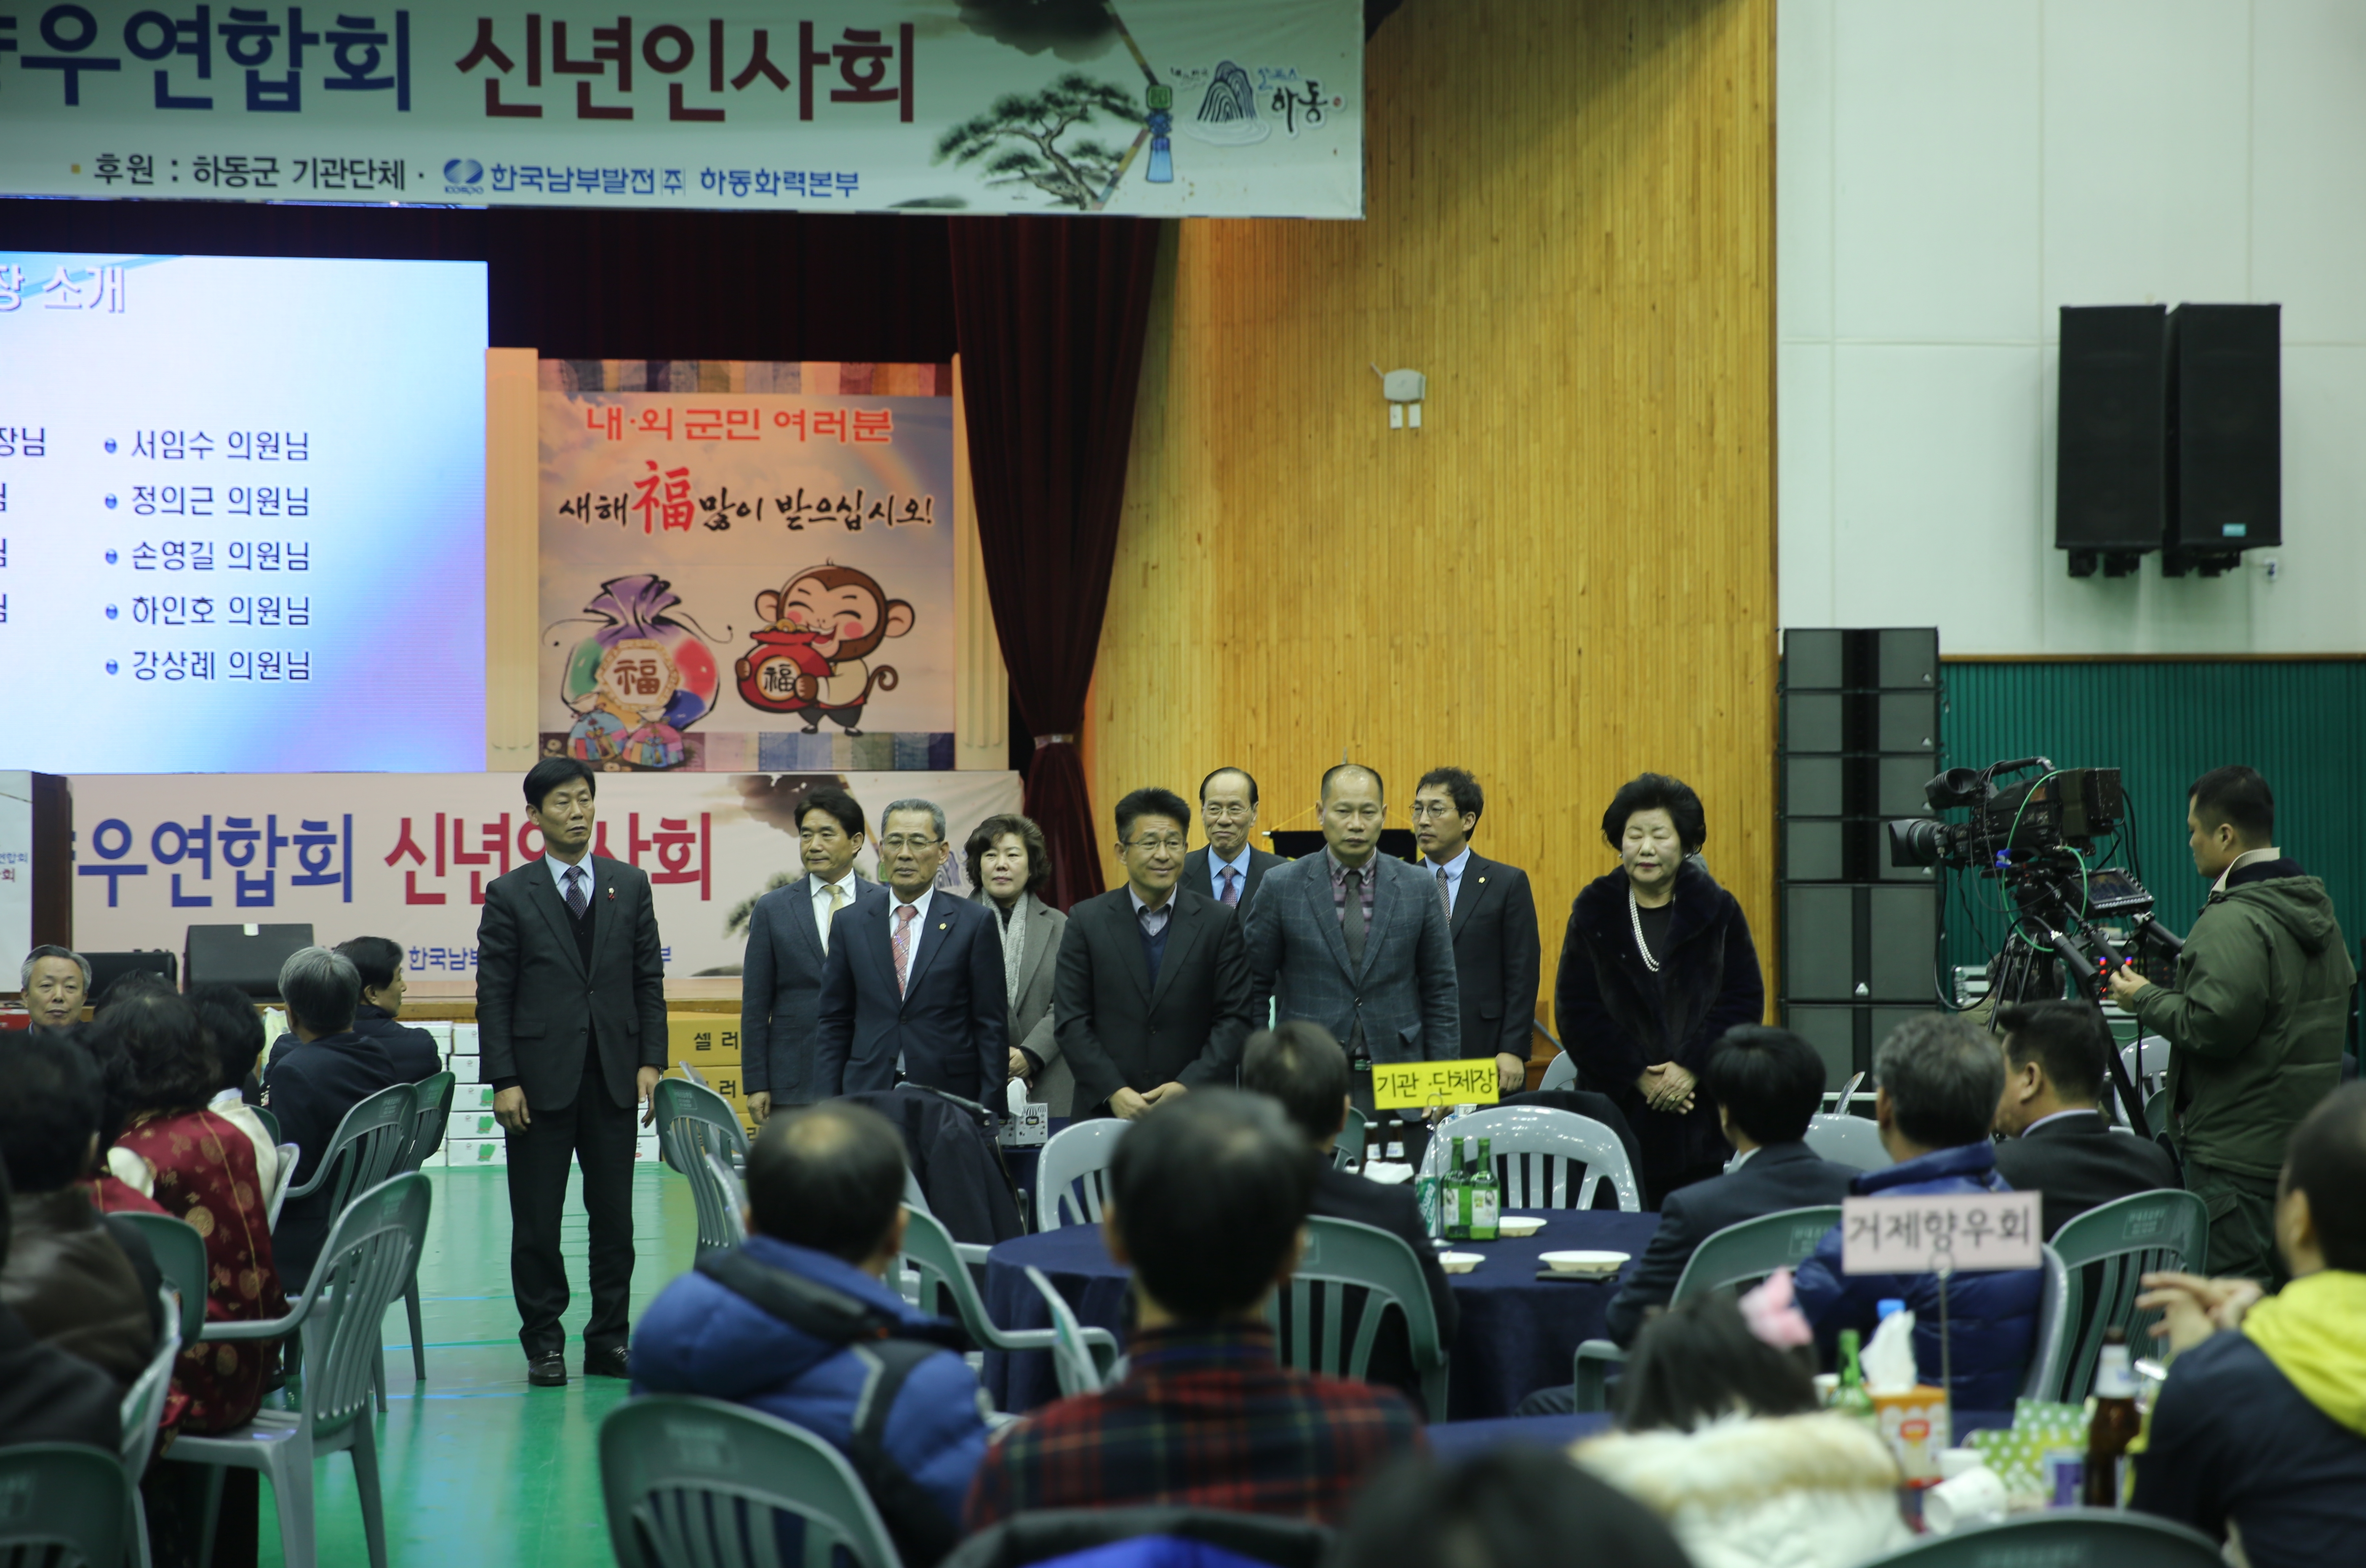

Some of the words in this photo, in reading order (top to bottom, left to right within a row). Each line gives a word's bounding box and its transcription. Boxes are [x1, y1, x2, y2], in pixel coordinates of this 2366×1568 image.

[0, 3, 411, 112] 우연합회
[455, 13, 914, 123] 신년인사회
[1271, 80, 1328, 133] 하동
[94, 153, 154, 185] 후원
[192, 155, 280, 188] 하동군
[293, 157, 405, 191] 기관단체
[491, 163, 654, 194] 한국남부발전
[700, 166, 859, 197] 하동화력본부
[44, 266, 125, 313] 소개
[685, 409, 760, 440] 군민
[774, 409, 892, 442] 여러분
[132, 431, 213, 459] 서임수
[228, 432, 307, 461] 의원님
[133, 487, 213, 515] 정의근
[228, 487, 308, 516] 의원님
[559, 492, 628, 526] 새해
[632, 461, 695, 534] 福
[699, 487, 763, 531] 많이
[133, 541, 214, 570] 손영길
[229, 542, 308, 570] 의원님
[133, 596, 214, 625] 하인호
[229, 597, 309, 625] 의원님
[229, 652, 309, 680] 의원님
[614, 660, 660, 695] 福
[763, 664, 795, 692] 福
[72, 813, 352, 908] 우연합회
[1377, 1073, 1419, 1098] 기관
[1849, 1206, 2030, 1252] 거제향우회
